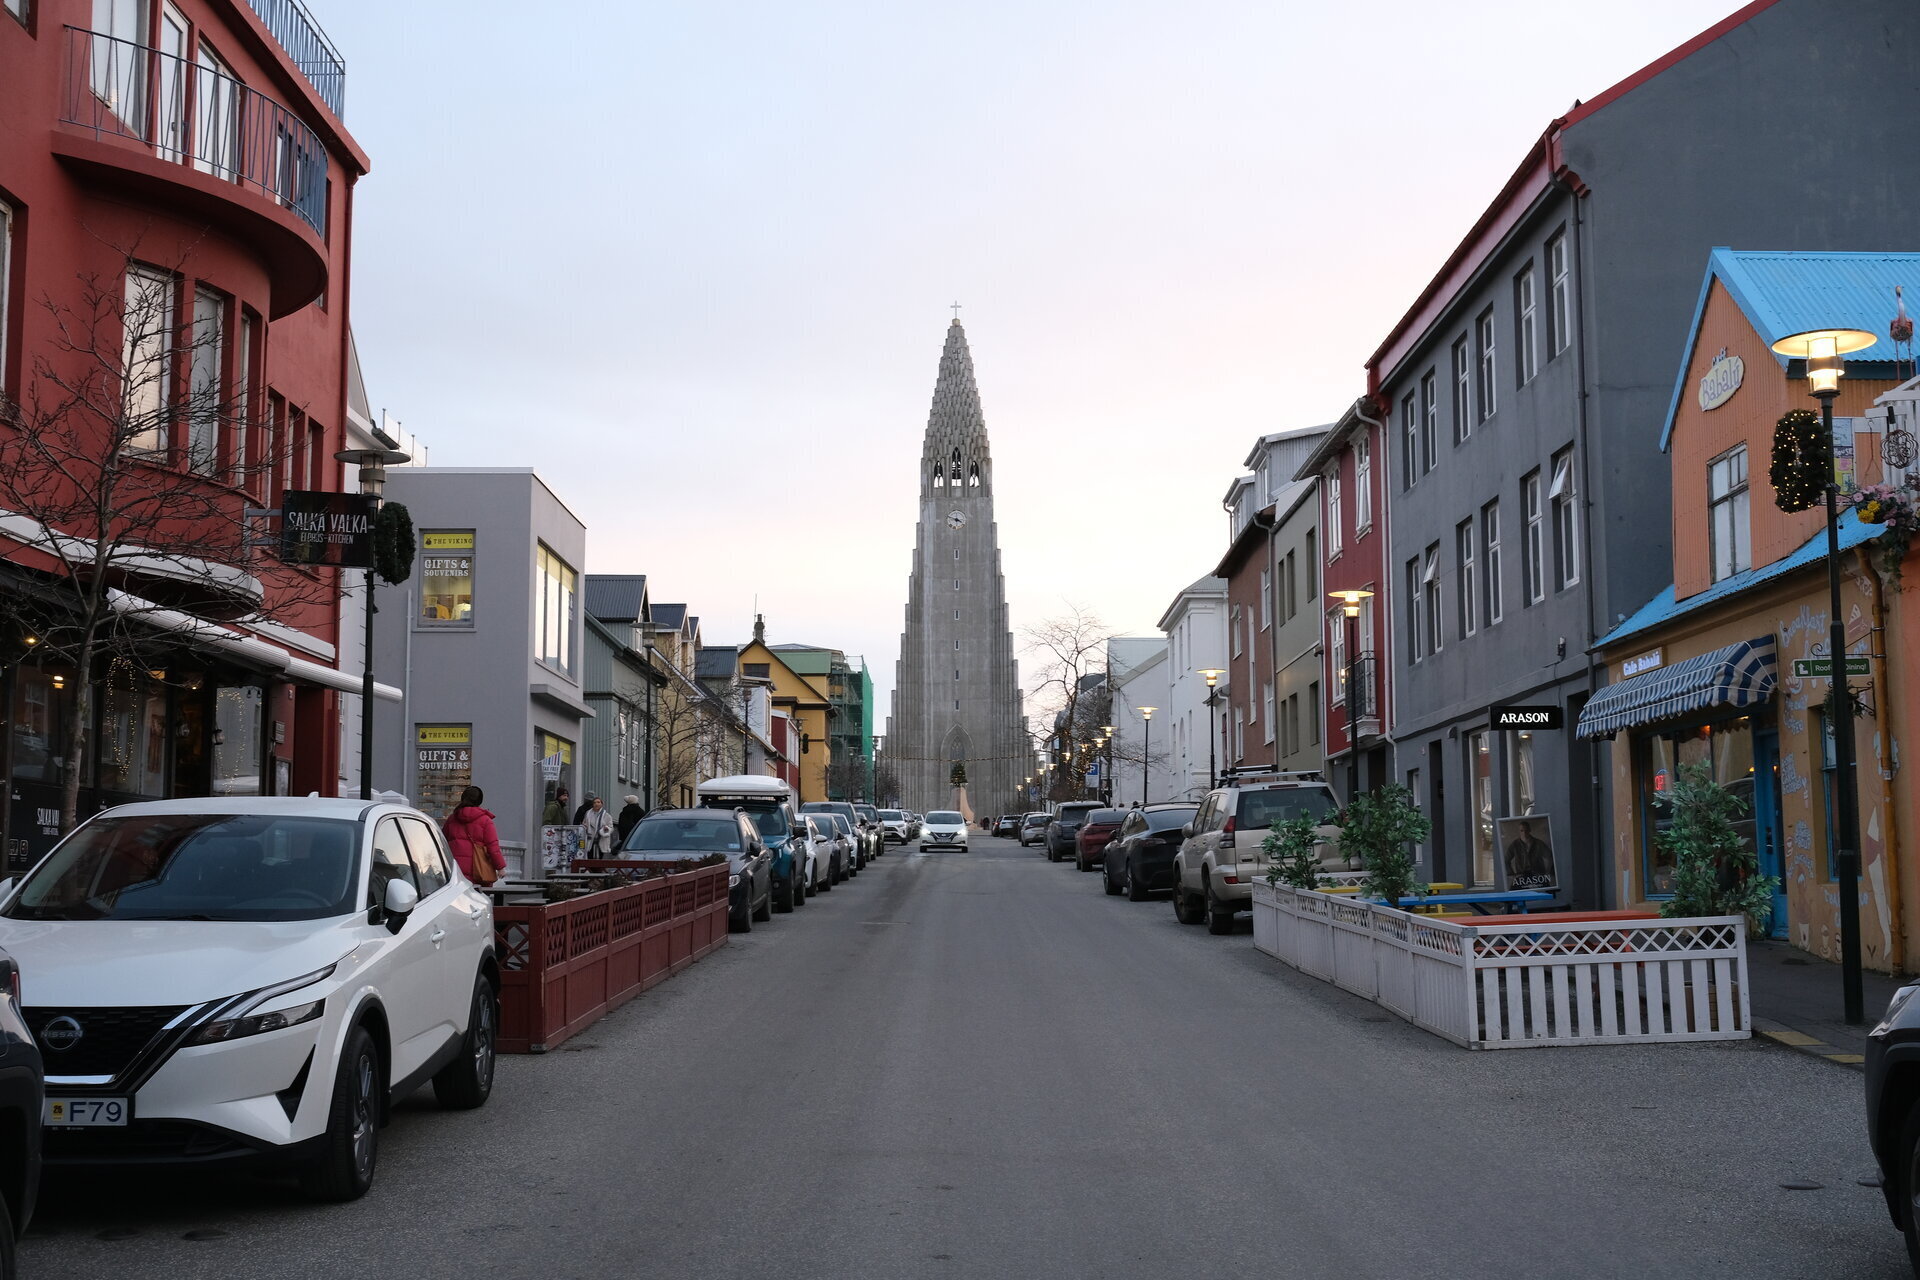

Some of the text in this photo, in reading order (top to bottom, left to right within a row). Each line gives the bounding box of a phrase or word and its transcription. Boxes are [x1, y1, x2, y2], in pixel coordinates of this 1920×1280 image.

[1702, 357, 1740, 409] Babalú
[288, 511, 368, 533] SALKA VALKA
[424, 559, 469, 569] GIFTS &
[424, 569, 469, 577] SOUVENIRS
[1814, 663, 1832, 672] Roof
[1499, 712, 1549, 724] ARASON
[419, 750, 469, 761] GIFTS &
[418, 761, 469, 770] SOUVENIRS
[1512, 874, 1552, 886] ARASON
[40, 1030, 84, 1038] NISSAN
[69, 1101, 122, 1122] F79
